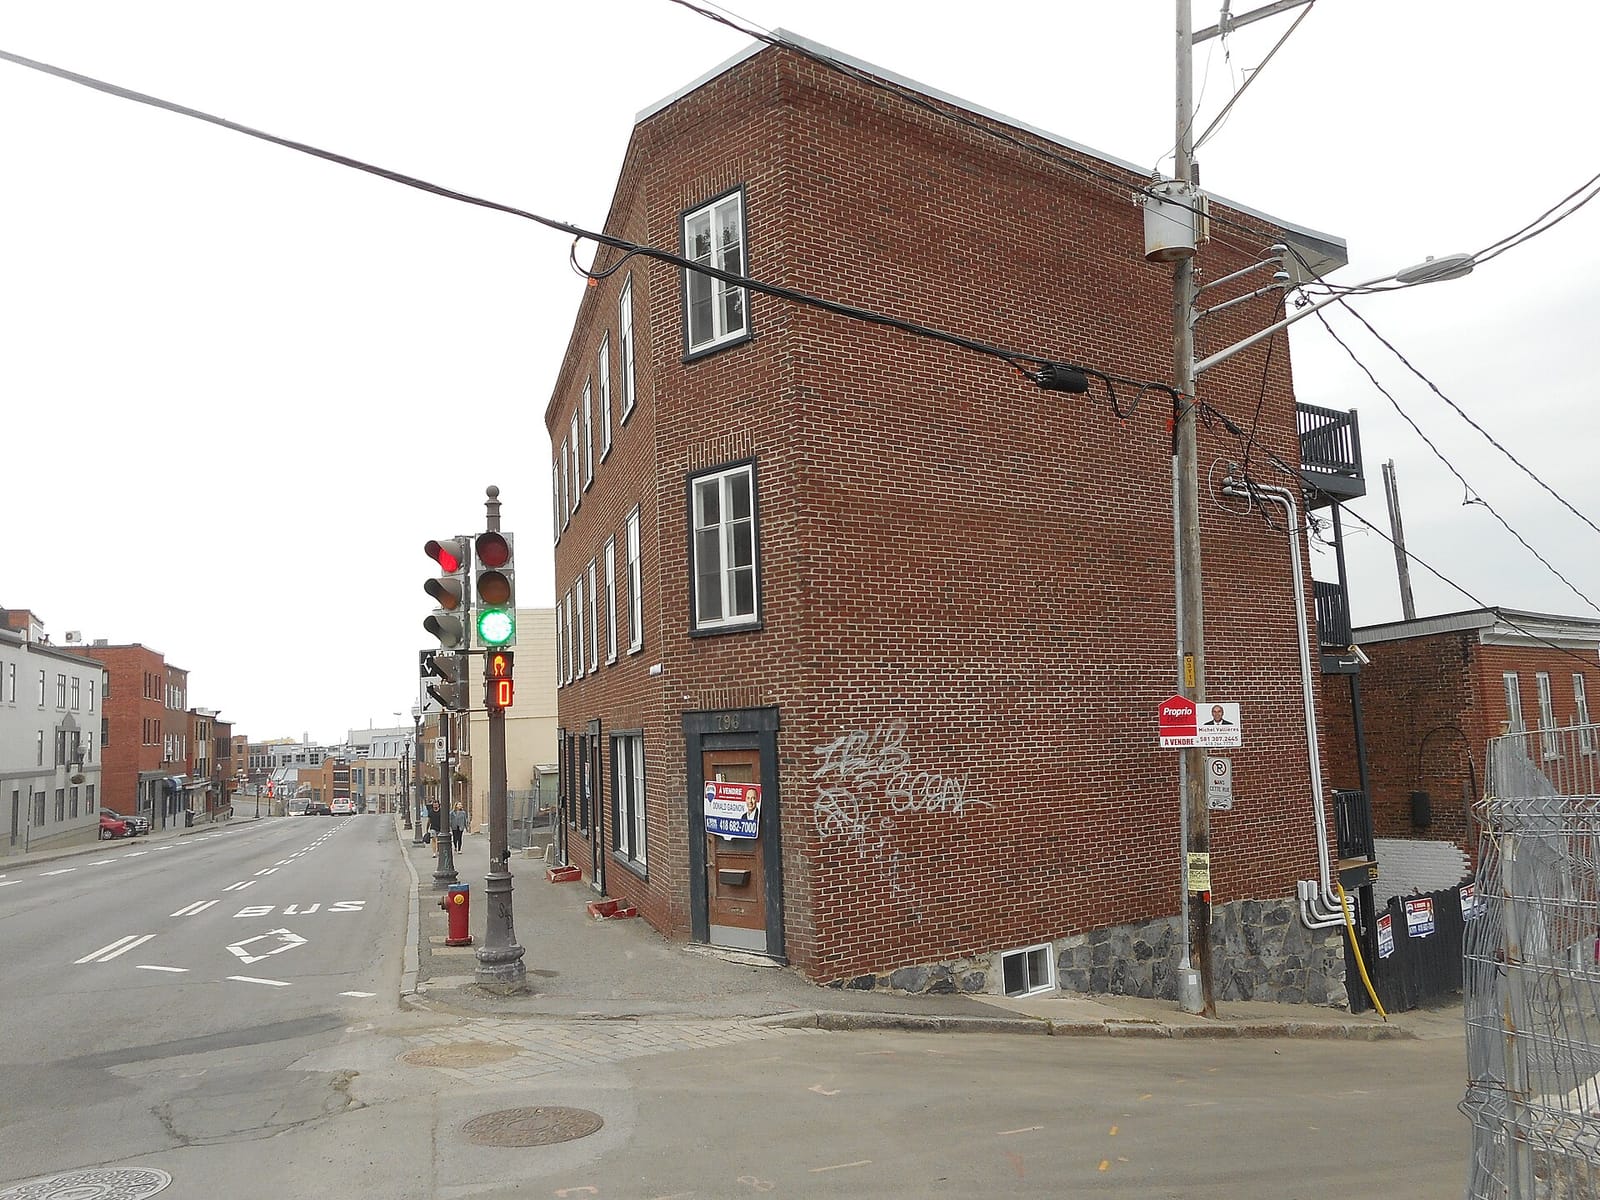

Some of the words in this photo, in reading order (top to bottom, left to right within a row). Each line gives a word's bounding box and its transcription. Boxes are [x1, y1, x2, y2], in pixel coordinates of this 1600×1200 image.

[1163, 706, 1192, 717] Proprio
[715, 714, 740, 730] 796
[1170, 738, 1194, 746] VENDRE
[723, 787, 743, 796] VENDRE
[719, 818, 728, 831] 418
[232, 901, 367, 918] BUS
